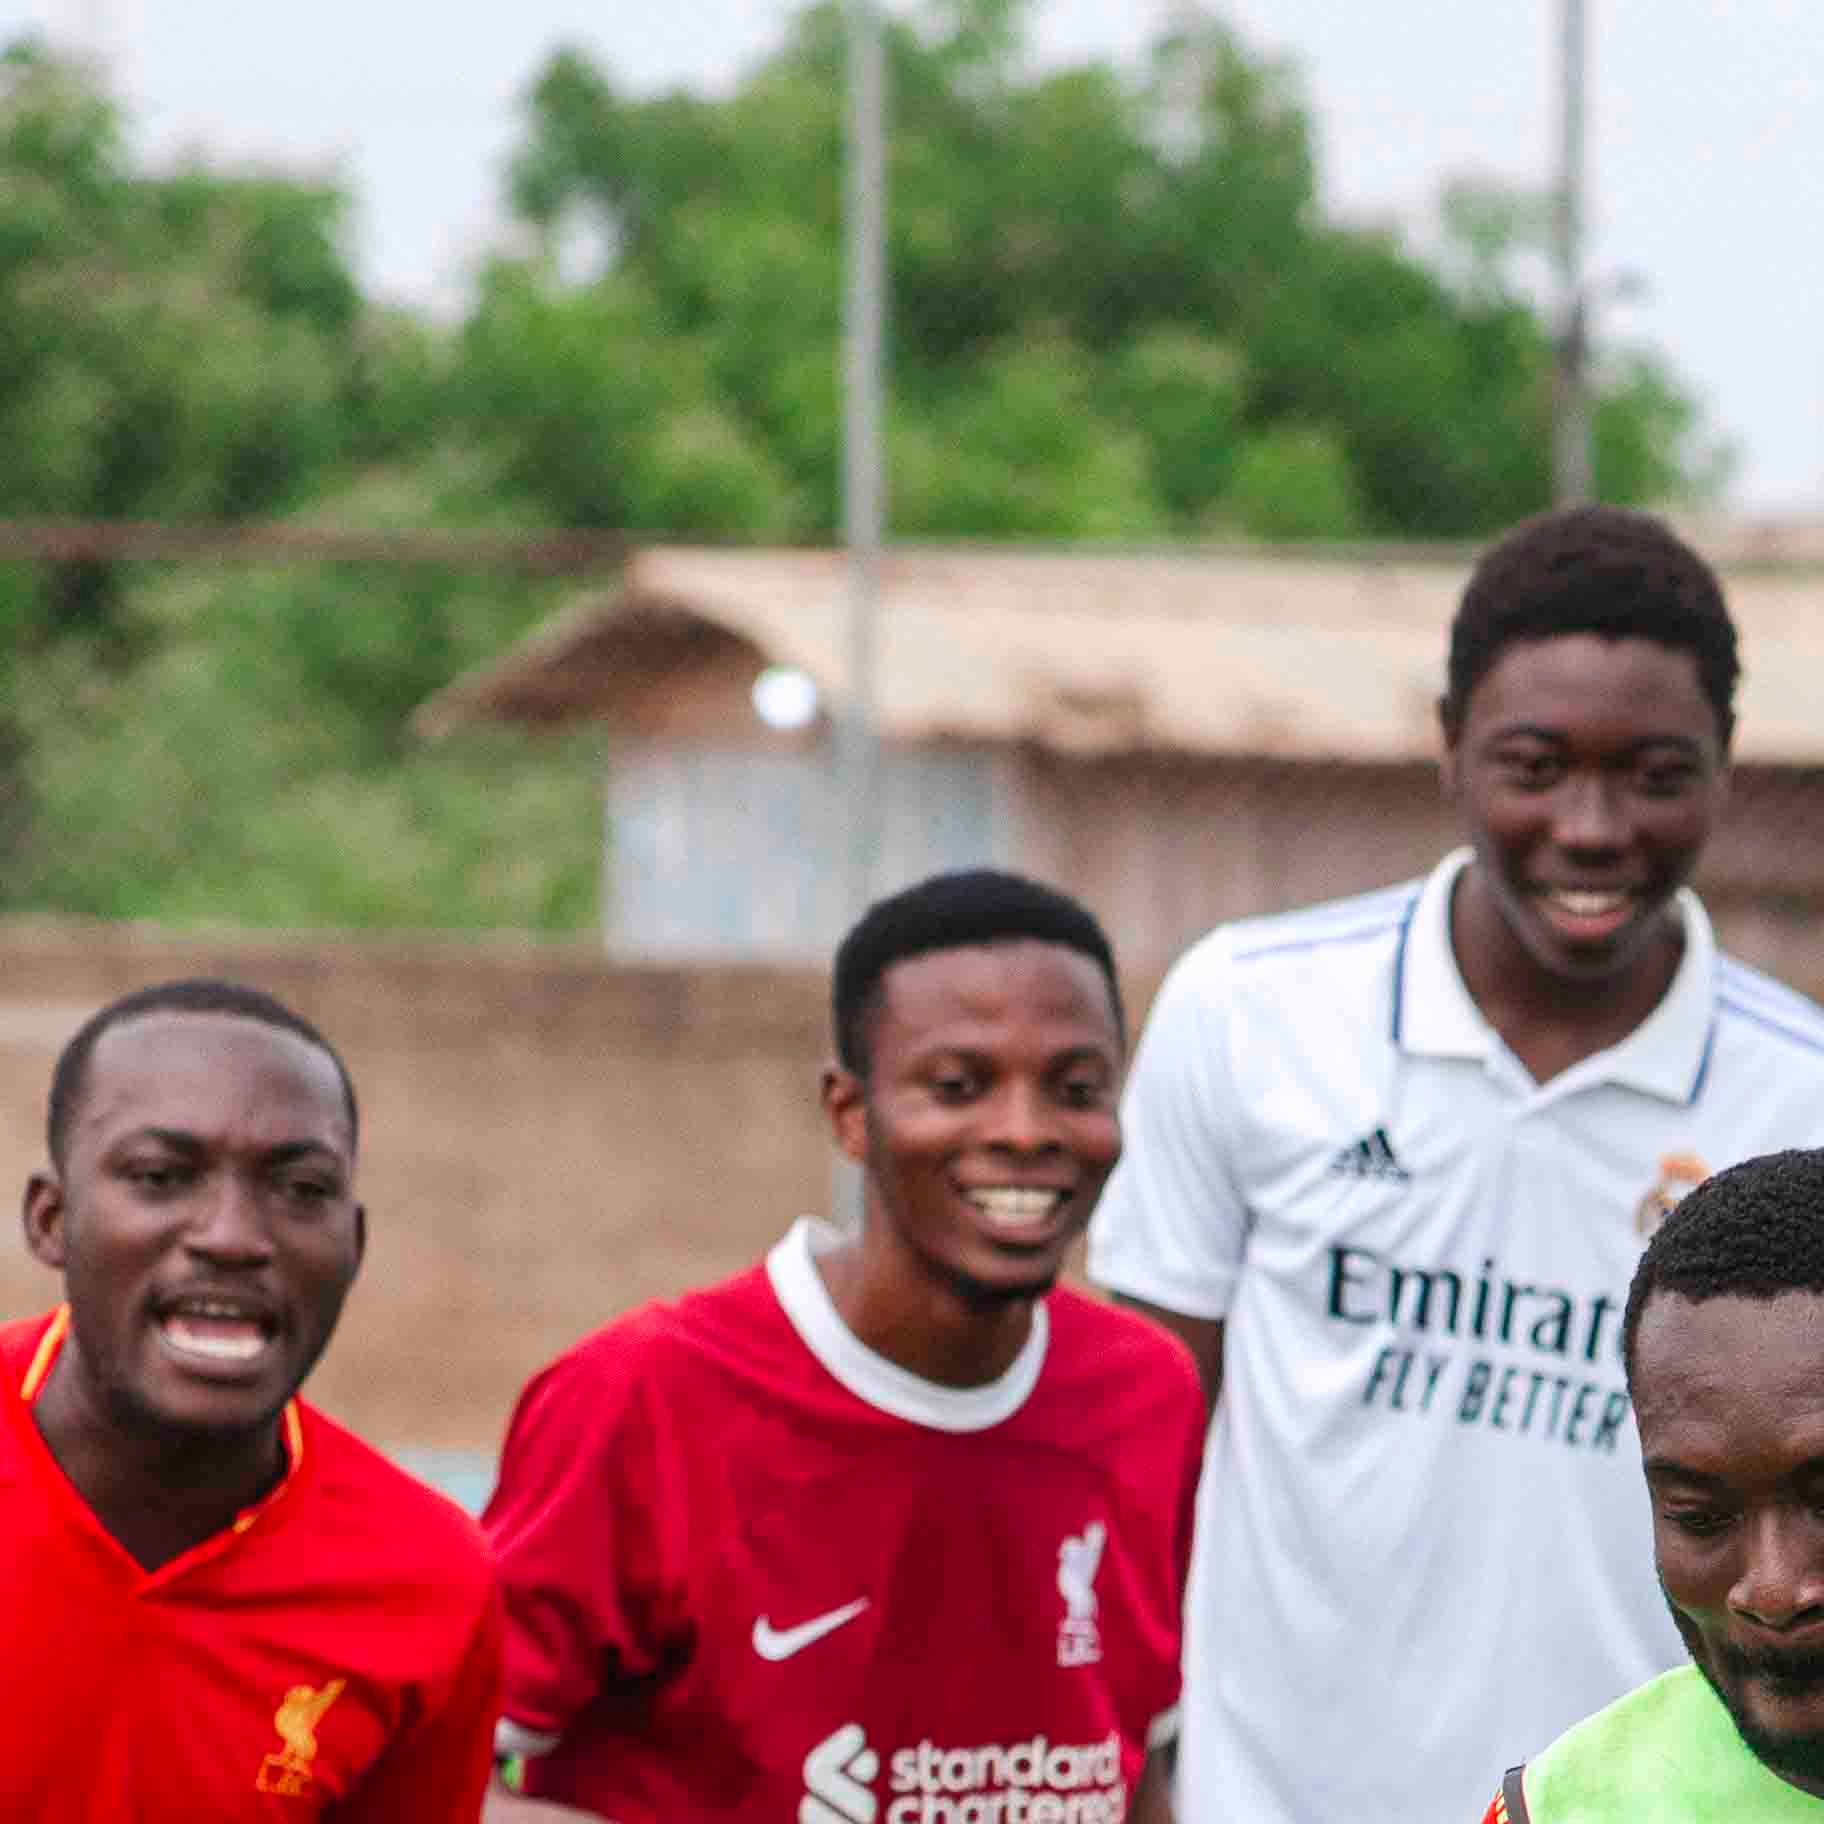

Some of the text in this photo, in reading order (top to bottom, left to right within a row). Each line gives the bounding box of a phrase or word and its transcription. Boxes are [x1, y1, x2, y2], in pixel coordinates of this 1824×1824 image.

[1325, 1245, 1626, 1361] Emirat
[1363, 1346, 1630, 1450] FLY BETTER
[890, 1730, 1120, 1793] standard
